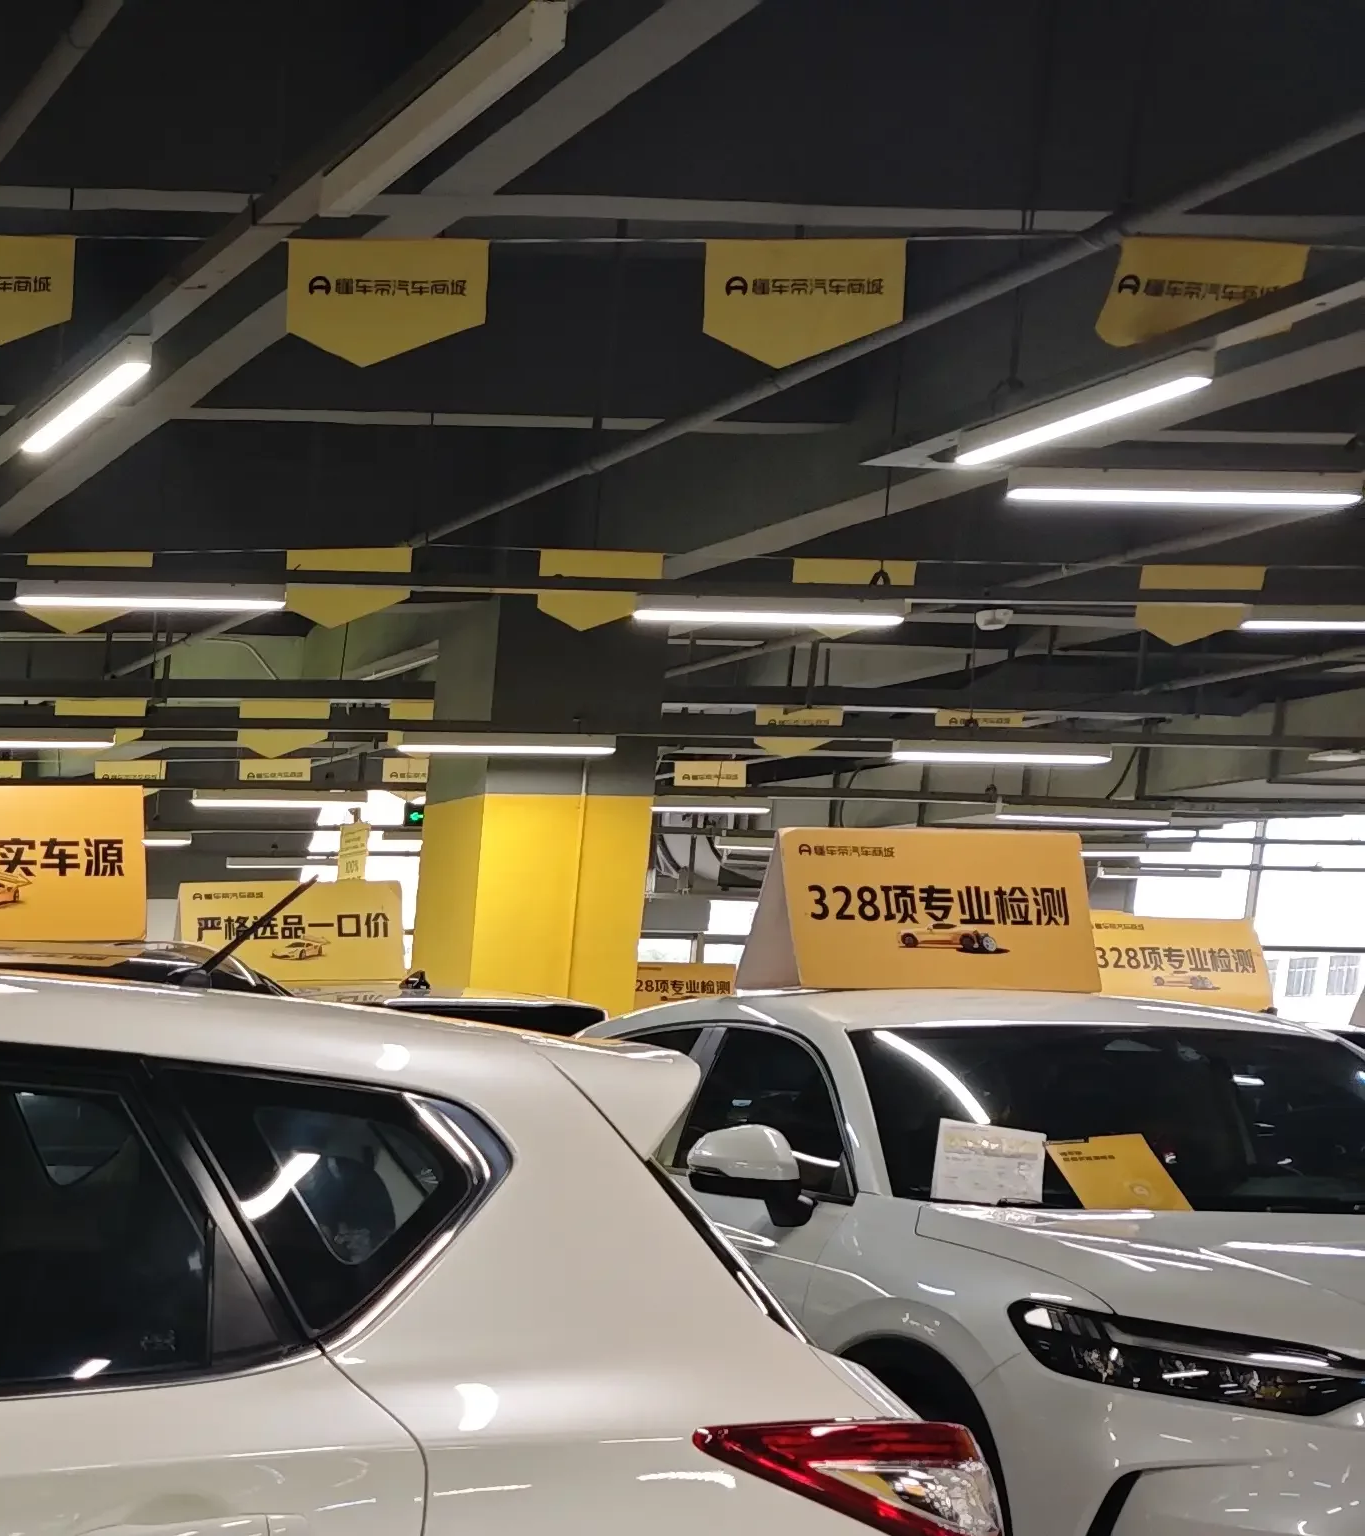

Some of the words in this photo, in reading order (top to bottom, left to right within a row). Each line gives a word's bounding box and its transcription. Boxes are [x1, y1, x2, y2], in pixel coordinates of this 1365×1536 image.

[335, 277, 467, 296] 懂车帝汽车商城
[752, 278, 884, 296] 懂车帝汽车商城
[807, 884, 1070, 926] 328项专业检测
